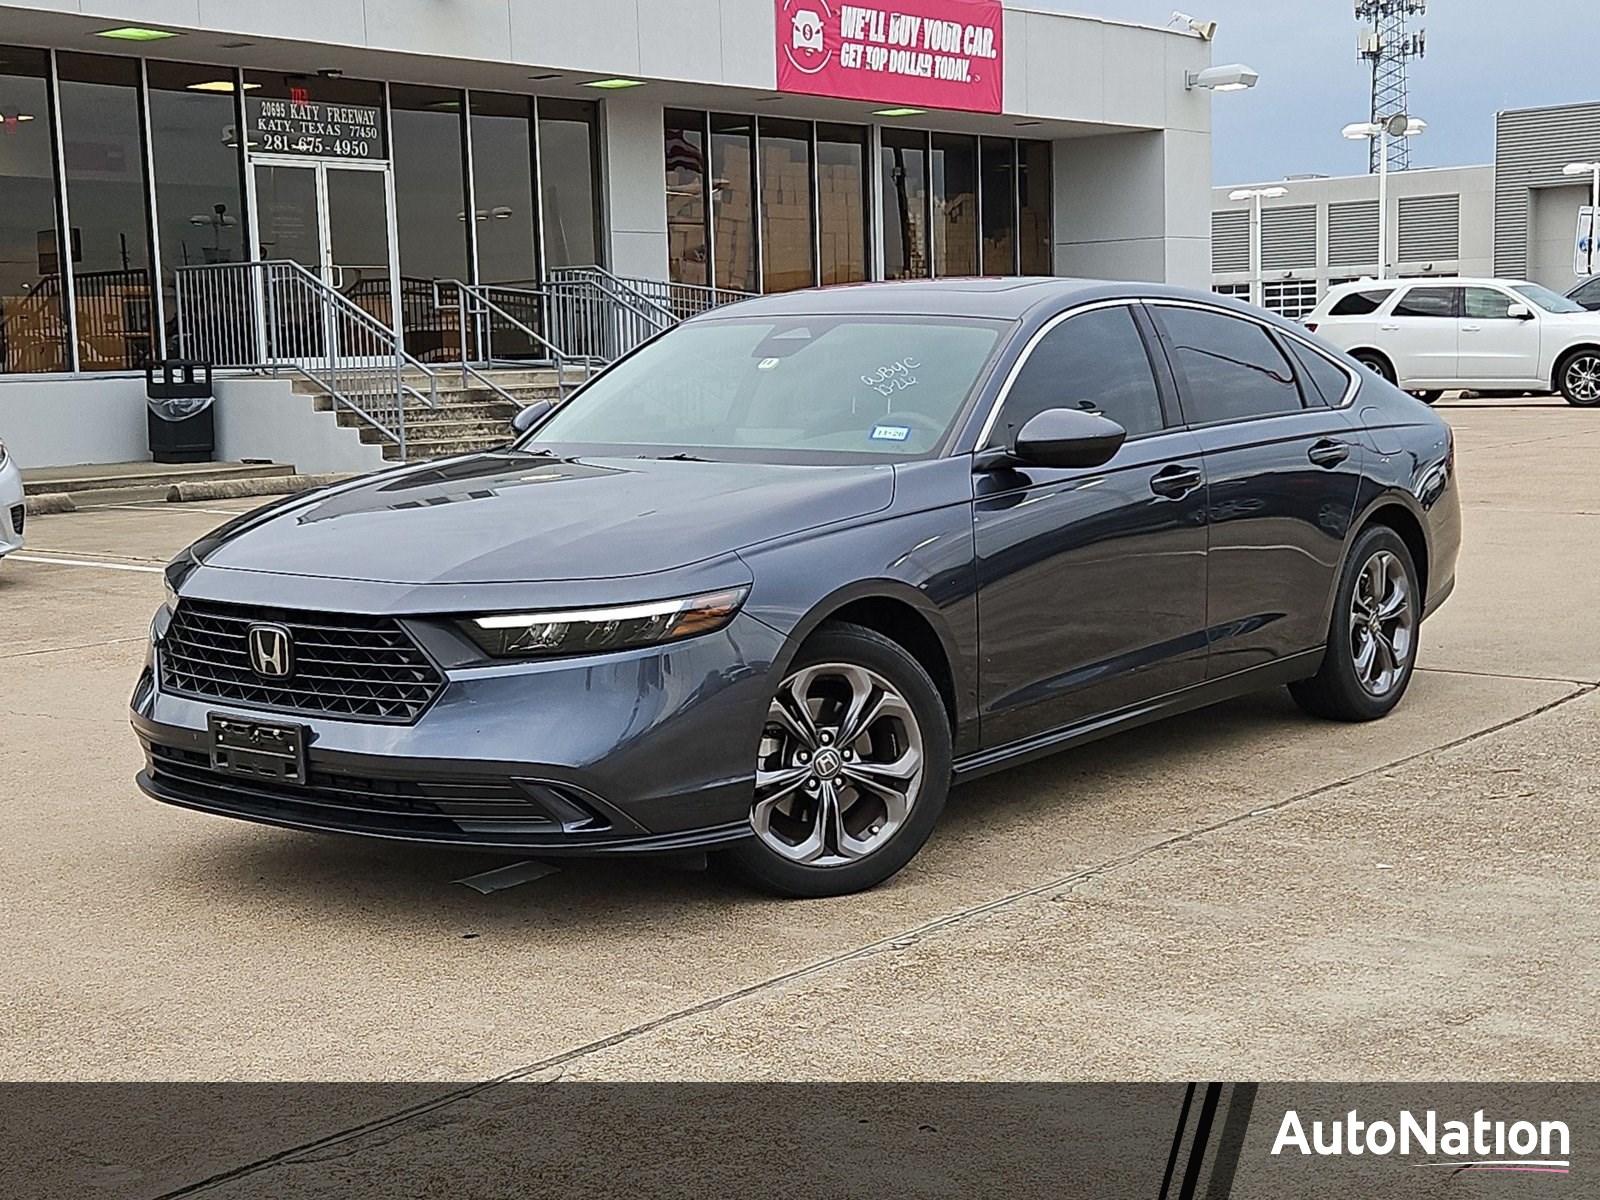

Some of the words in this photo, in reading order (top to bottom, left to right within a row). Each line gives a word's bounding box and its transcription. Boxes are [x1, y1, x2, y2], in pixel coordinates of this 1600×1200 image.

[841, 5, 886, 43] WE'LL
[888, 12, 922, 48] BUY
[923, 18, 962, 53] YOUR
[963, 25, 997, 59] CAR.
[840, 42, 864, 69] GET
[865, 45, 888, 72] TOP
[888, 49, 933, 77] DOLLAR
[934, 55, 972, 83] TODAY.
[257, 118, 294, 133] KATY,
[300, 121, 341, 136] TEXAS
[349, 125, 378, 139] 77450
[261, 101, 286, 118] 20695
[290, 103, 319, 121] KATY
[327, 106, 376, 126] FREEWAY
